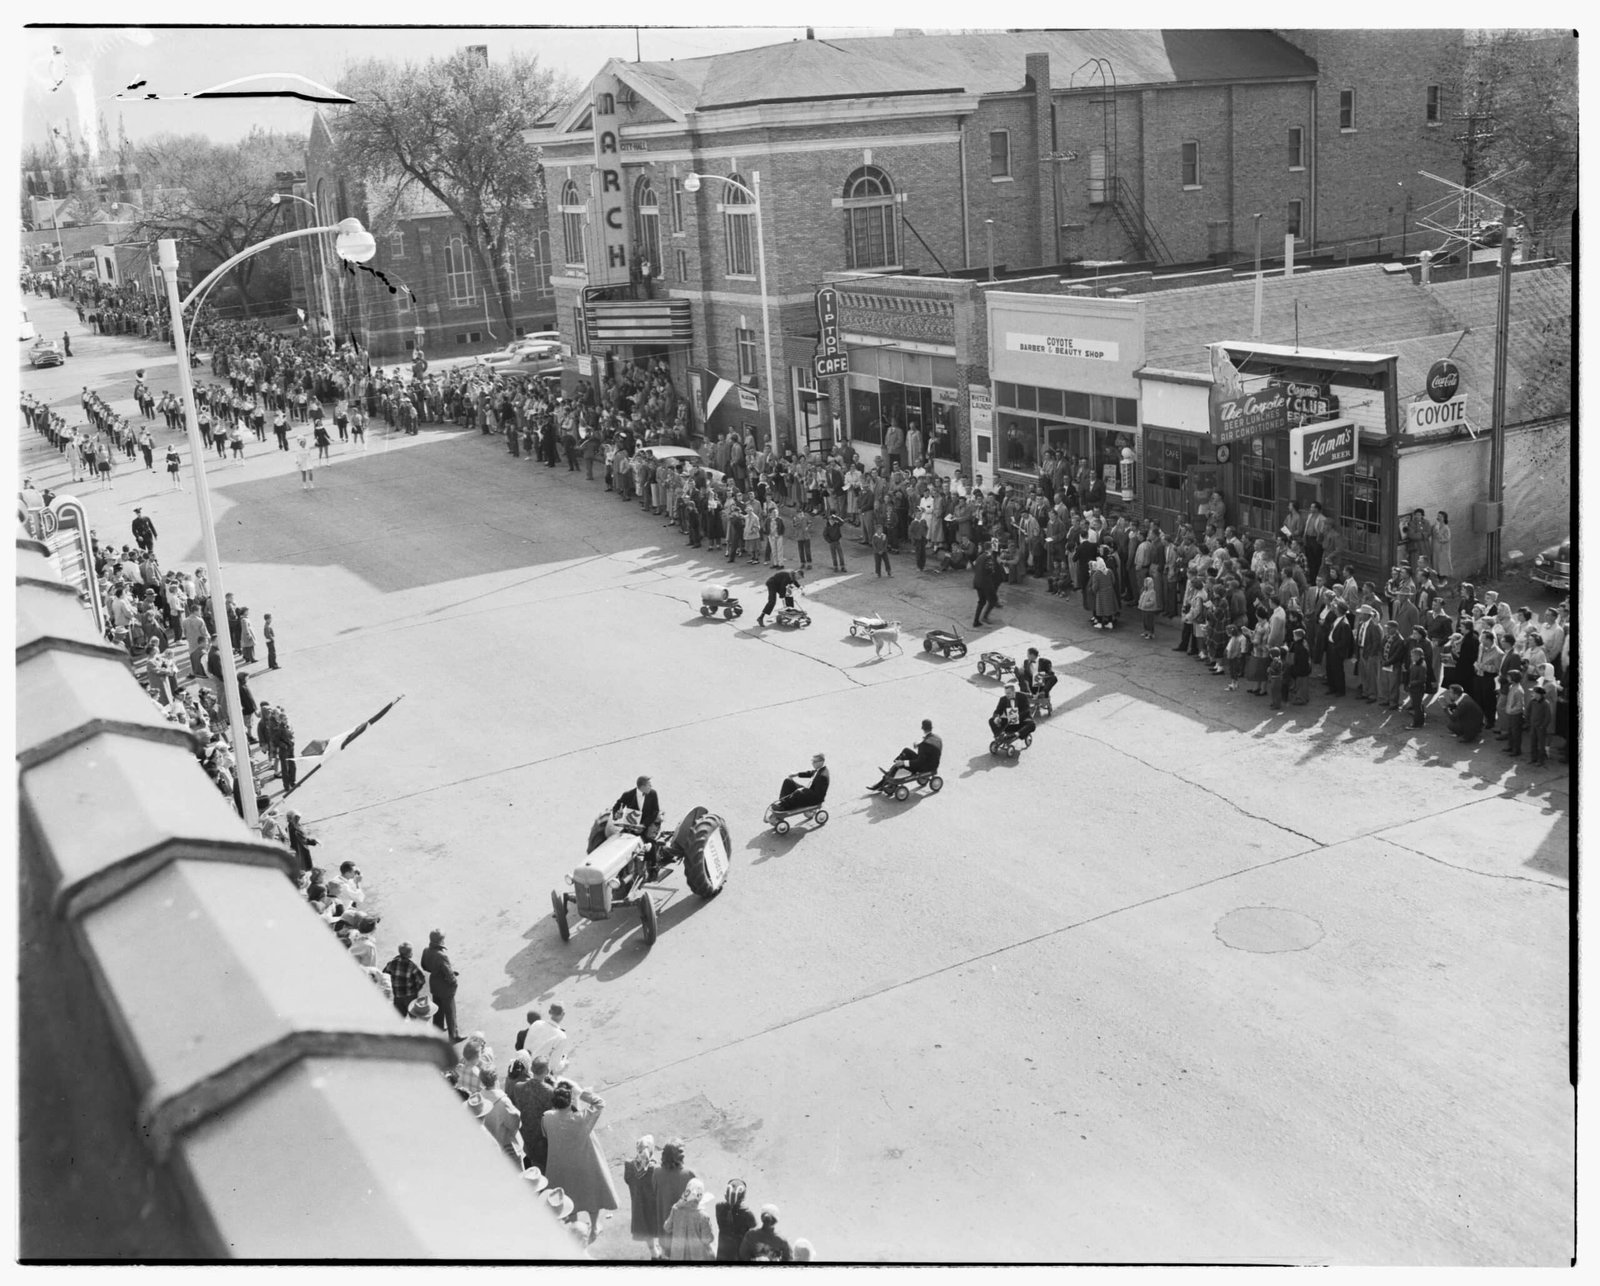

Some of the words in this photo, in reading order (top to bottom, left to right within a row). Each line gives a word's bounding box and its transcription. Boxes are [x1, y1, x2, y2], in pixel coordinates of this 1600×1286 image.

[597, 92, 626, 268] MARCH
[823, 293, 834, 322] TIP
[826, 326, 837, 355] TOP
[1019, 343, 1045, 353] BARBER
[1055, 347, 1082, 356] BEAUTY
[1084, 350, 1104, 358] SHOP
[1046, 337, 1073, 348] COYOTE
[817, 358, 847, 374] CAFE
[1432, 373, 1457, 388] Coca-Cola
[1221, 402, 1243, 420] The
[1244, 394, 1285, 415] Coyote
[1294, 399, 1326, 415] CLUB
[1416, 401, 1464, 426] COYOTE
[1221, 430, 1234, 442] AIR
[1235, 418, 1285, 439] CONDITIONED
[1224, 418, 1244, 431] BEER
[1246, 408, 1280, 425] LUNCHES
[1165, 449, 1179, 459] CAFE
[1305, 427, 1352, 466] Hamm's
[1331, 450, 1351, 461] BEER
